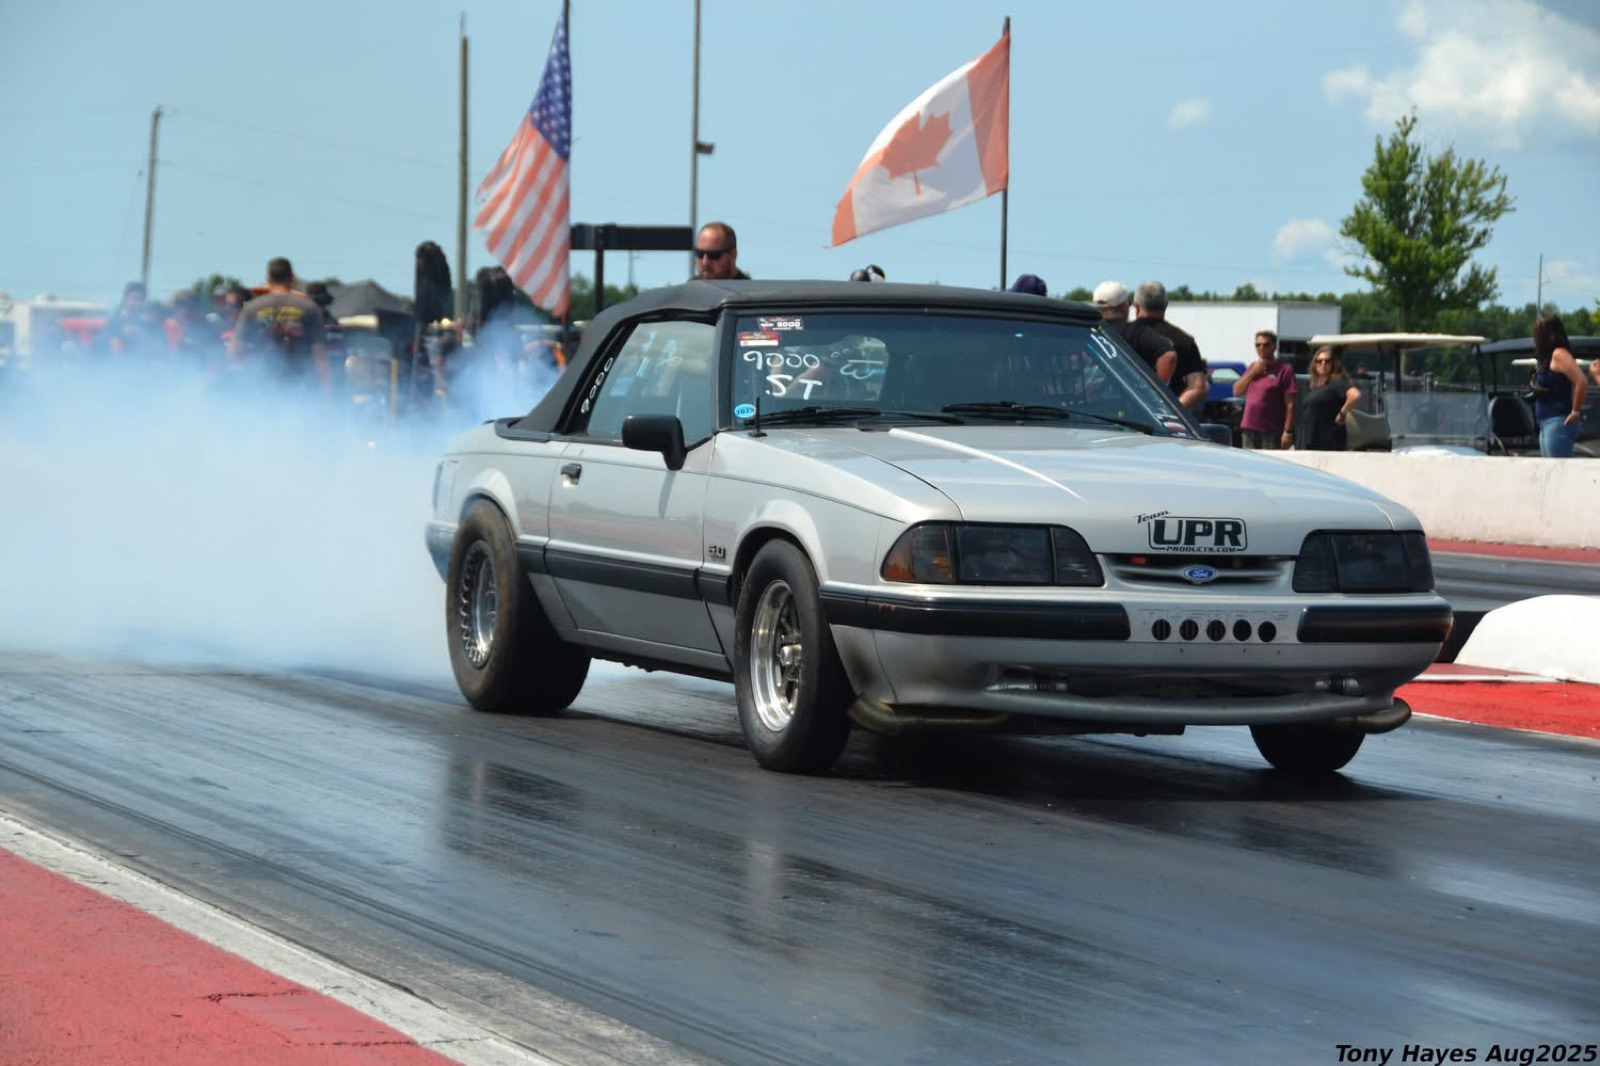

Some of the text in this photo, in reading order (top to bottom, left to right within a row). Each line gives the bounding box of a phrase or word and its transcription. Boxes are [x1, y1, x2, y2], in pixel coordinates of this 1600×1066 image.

[743, 351, 820, 370] 9000
[1133, 510, 1171, 524] Team
[1153, 519, 1242, 547] UPR
[1166, 545, 1236, 553] PRODUCTS.COM
